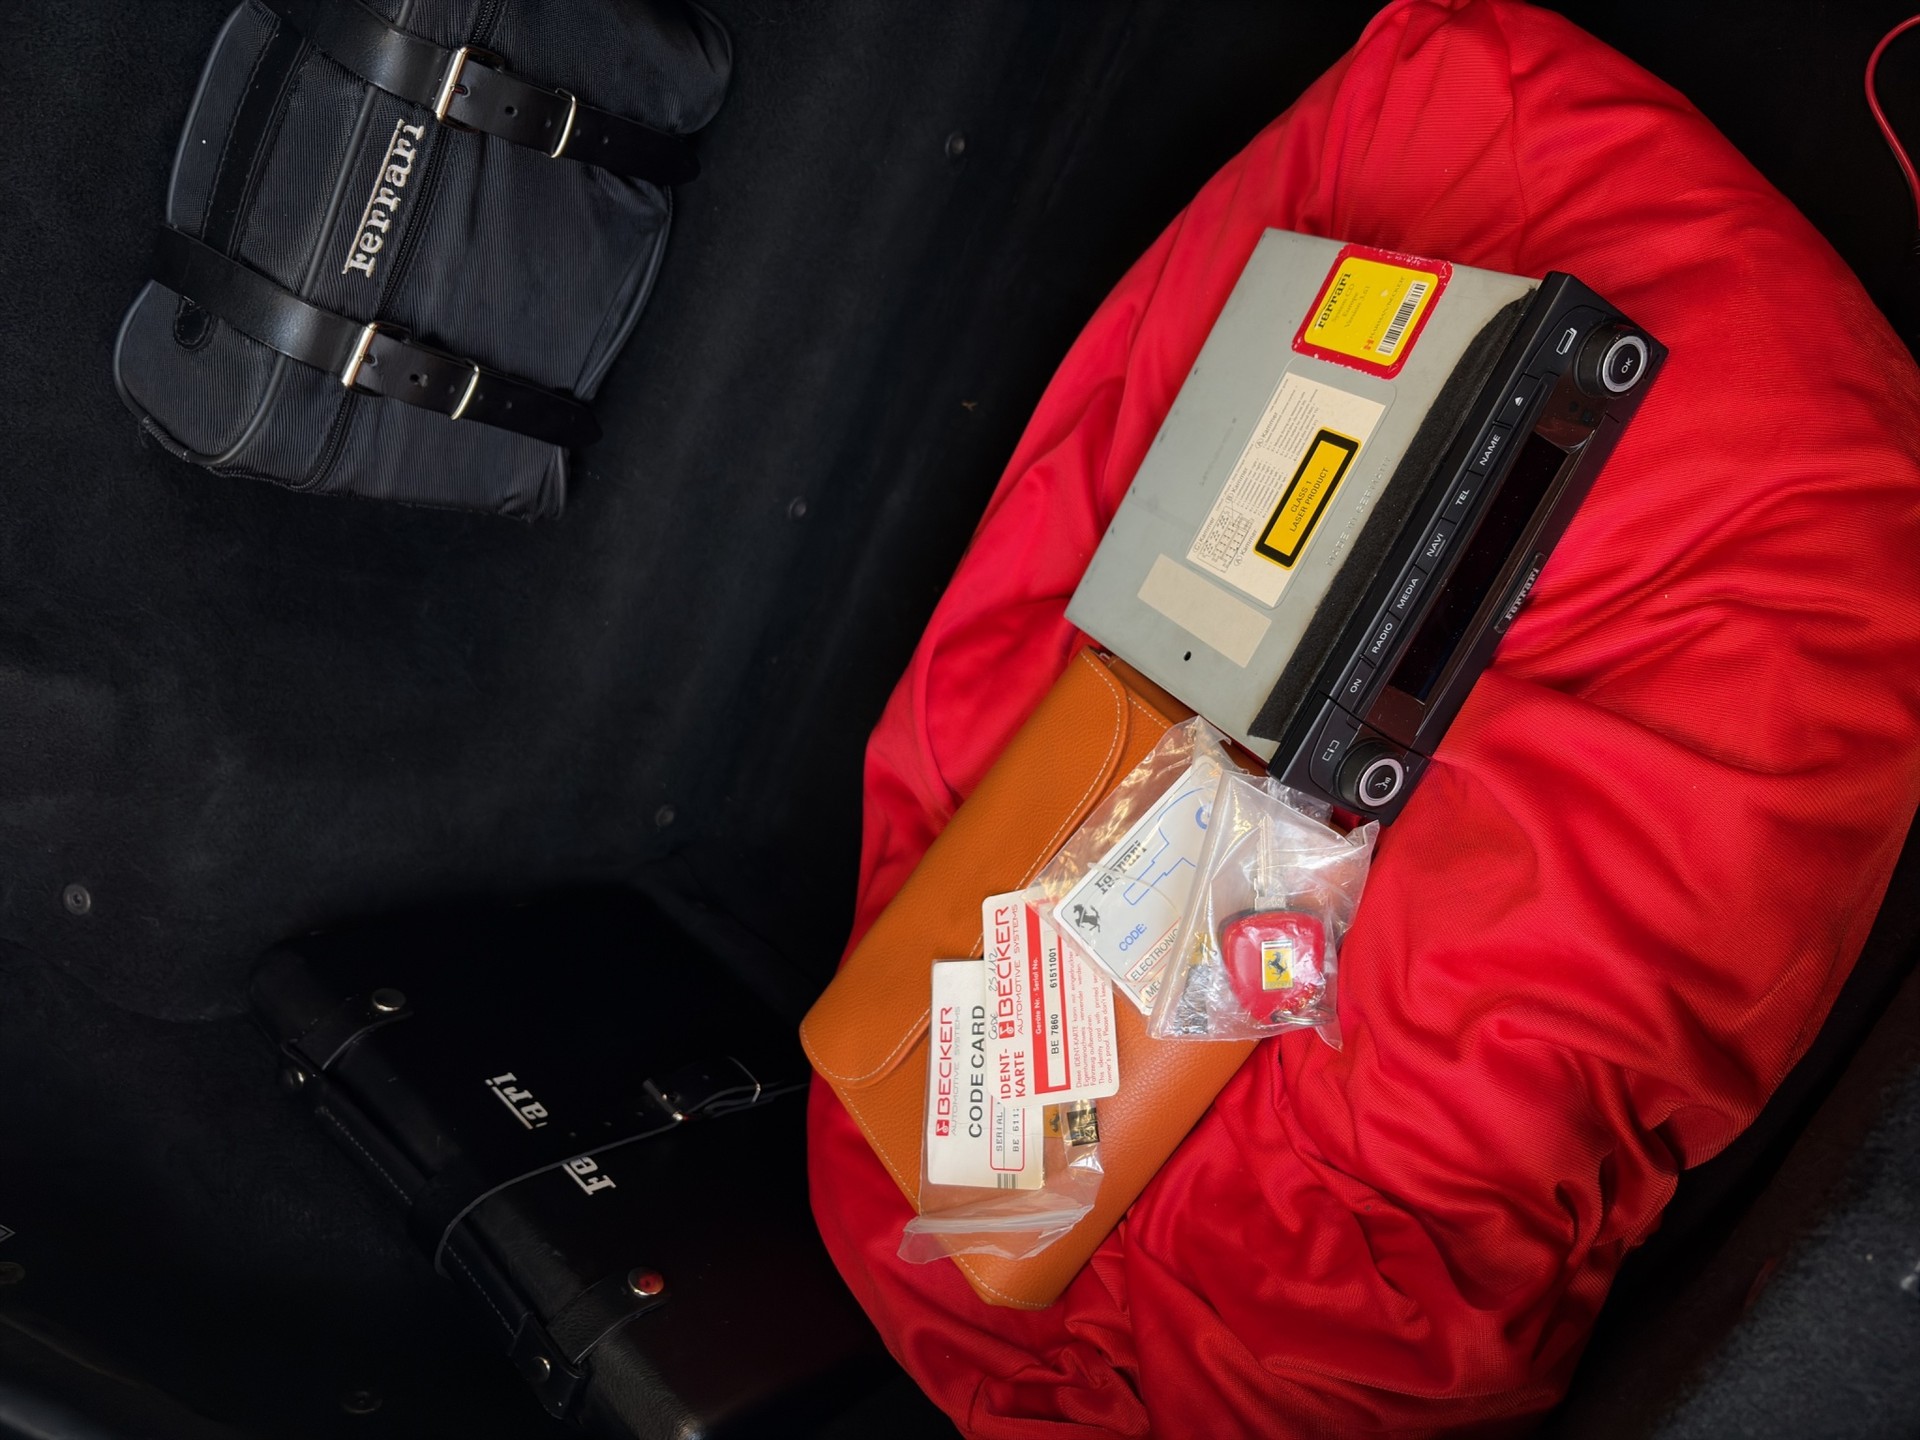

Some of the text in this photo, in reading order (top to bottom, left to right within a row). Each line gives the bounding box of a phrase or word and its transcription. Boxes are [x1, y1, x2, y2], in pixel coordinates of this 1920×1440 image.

[341, 118, 426, 277] Ferrari
[1620, 357, 1633, 374] OK
[1260, 410, 1279, 438] Kammer
[1478, 433, 1501, 466] NAME
[1289, 466, 1329, 532] LASER PRODUCT
[1289, 486, 1308, 513] CLASS
[1454, 486, 1470, 507] TEL
[1239, 528, 1258, 556] Kammer
[1425, 531, 1445, 558] NAVI
[1395, 575, 1420, 610] MEDIA
[1369, 620, 1394, 655] RADIO
[1348, 676, 1362, 694] ON
[1118, 922, 1147, 951] CODE:
[995, 906, 1013, 1016] BECKER
[1011, 904, 1023, 1034] AUTOMOTIVE SYSTEMS
[1049, 947, 1058, 1053] BE 7860 61511001
[937, 1006, 952, 1115] BECKER
[968, 1005, 985, 1137] CODE CARD
[998, 1048, 1011, 1099] IDENT-
[1014, 1050, 1025, 1096] KARTE
[483, 1071, 615, 1195] Feari
[1012, 1139, 1019, 1151] BE
